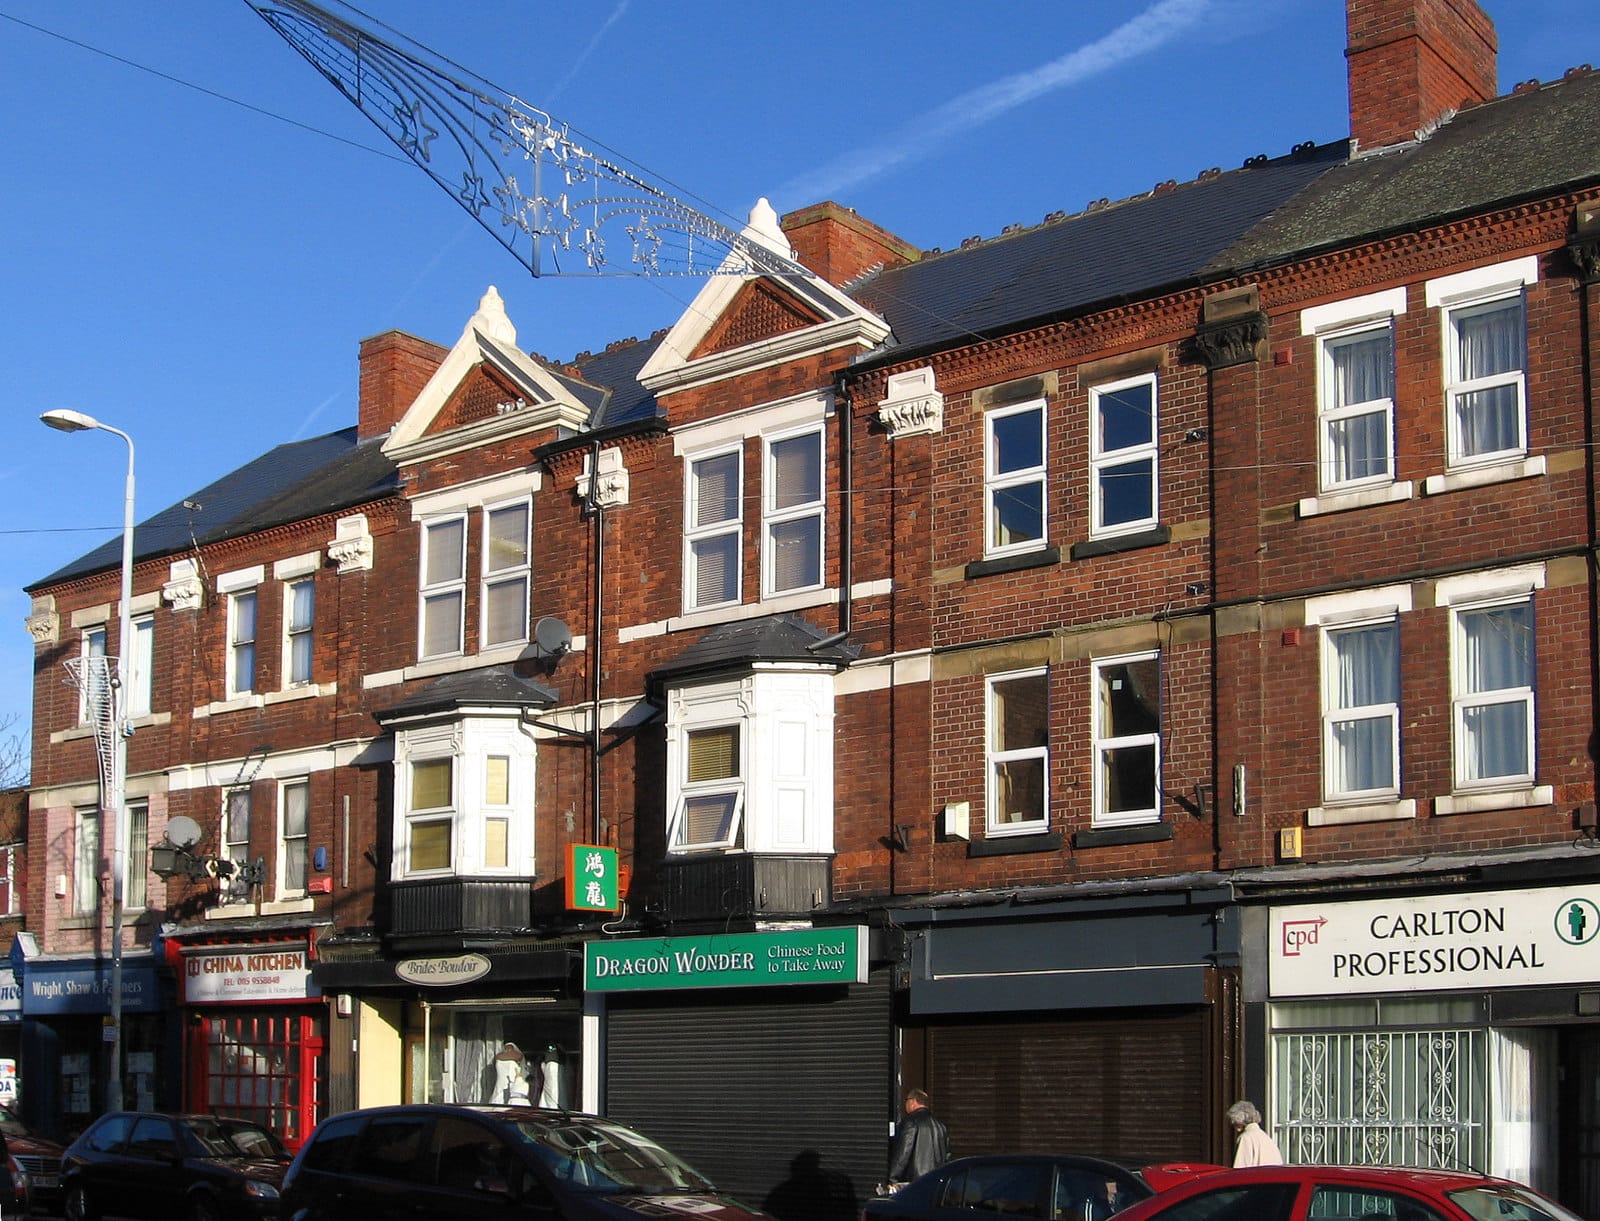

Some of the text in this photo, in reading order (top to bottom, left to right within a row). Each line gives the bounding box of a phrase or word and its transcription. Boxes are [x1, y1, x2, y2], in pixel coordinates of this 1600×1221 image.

[585, 852, 606, 907] 鴻龍
[1370, 907, 1505, 940] CARLTON
[1286, 924, 1319, 952] cpd
[595, 946, 755, 978] DRAGON WONDER
[767, 941, 846, 960] Chinese Food
[1333, 943, 1545, 978] PROFESSIONAL
[203, 953, 303, 974] CHINA KITCHEN
[438, 957, 479, 974] Boudoir
[767, 957, 846, 973] to Take Away
[32, 981, 63, 999] Wright,
[66, 980, 91, 996] Shaw
[102, 979, 142, 995] Paners
